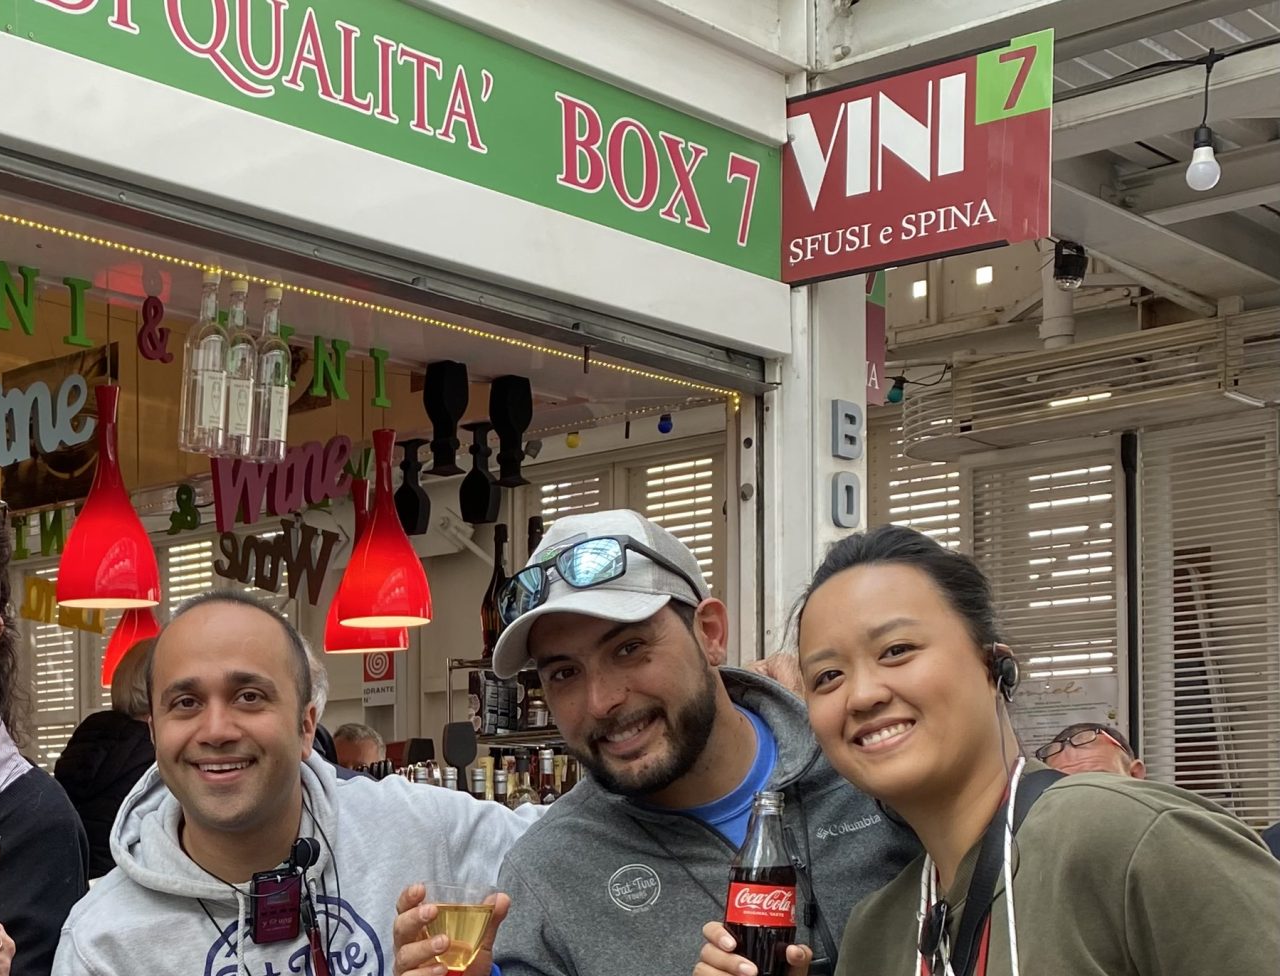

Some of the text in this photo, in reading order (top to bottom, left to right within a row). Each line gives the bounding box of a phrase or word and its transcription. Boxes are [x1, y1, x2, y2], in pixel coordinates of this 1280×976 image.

[998, 45, 1038, 111] 7
[163, 0, 761, 248] QUALITA' BOX 7
[786, 72, 967, 212] VINI
[789, 199, 997, 265] SFUSI e SPINA
[137, 296, 174, 364] &
[211, 436, 353, 532] Wine
[832, 399, 864, 528] BO
[363, 686, 395, 696] IDRANTE
[828, 814, 881, 837] Columbia
[734, 888, 793, 912] Coca-Cola
